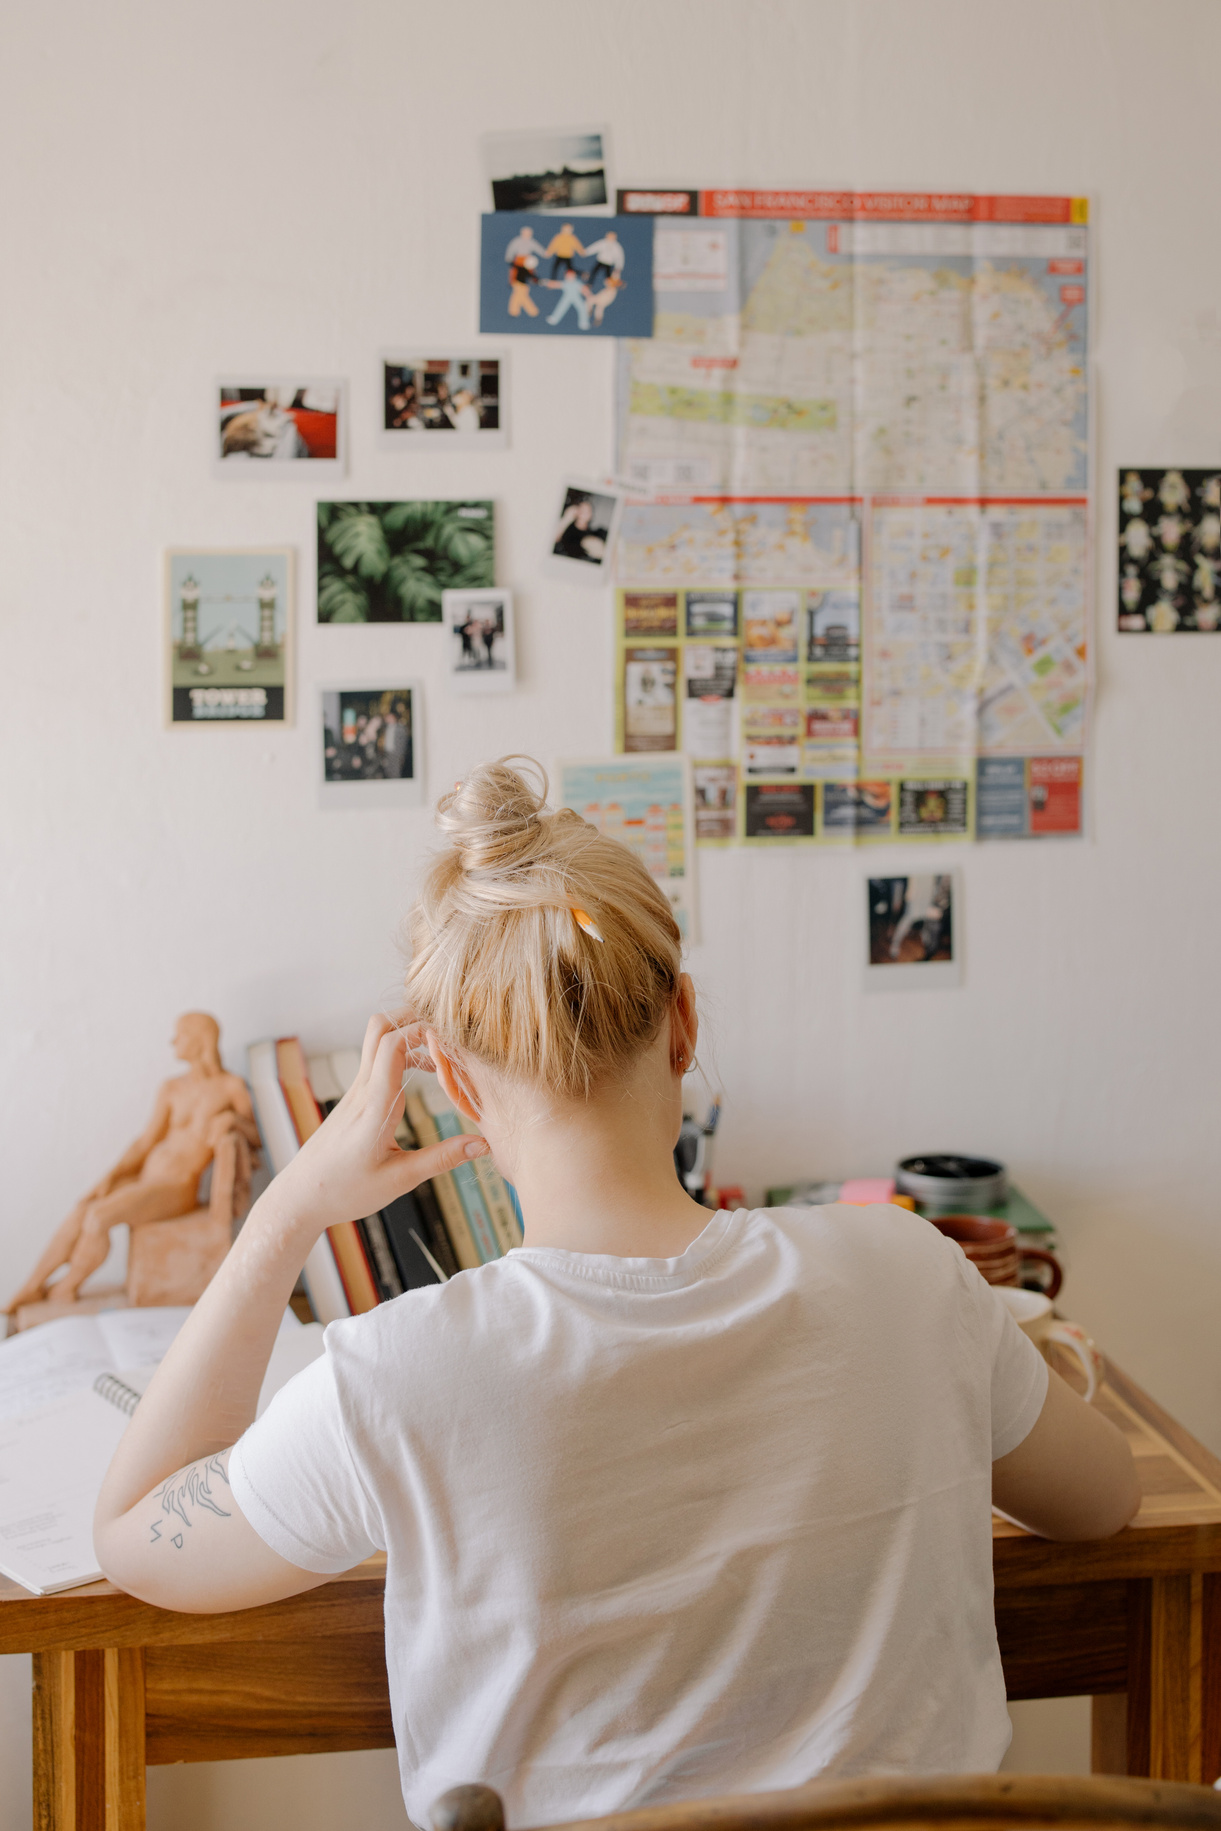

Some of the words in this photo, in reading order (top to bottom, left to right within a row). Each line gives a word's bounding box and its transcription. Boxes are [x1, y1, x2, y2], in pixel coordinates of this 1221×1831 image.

[711, 192, 751, 208] SAN
[752, 192, 858, 211] FRANCISCO
[863, 194, 926, 213] VISITOR
[929, 195, 972, 214] MAP
